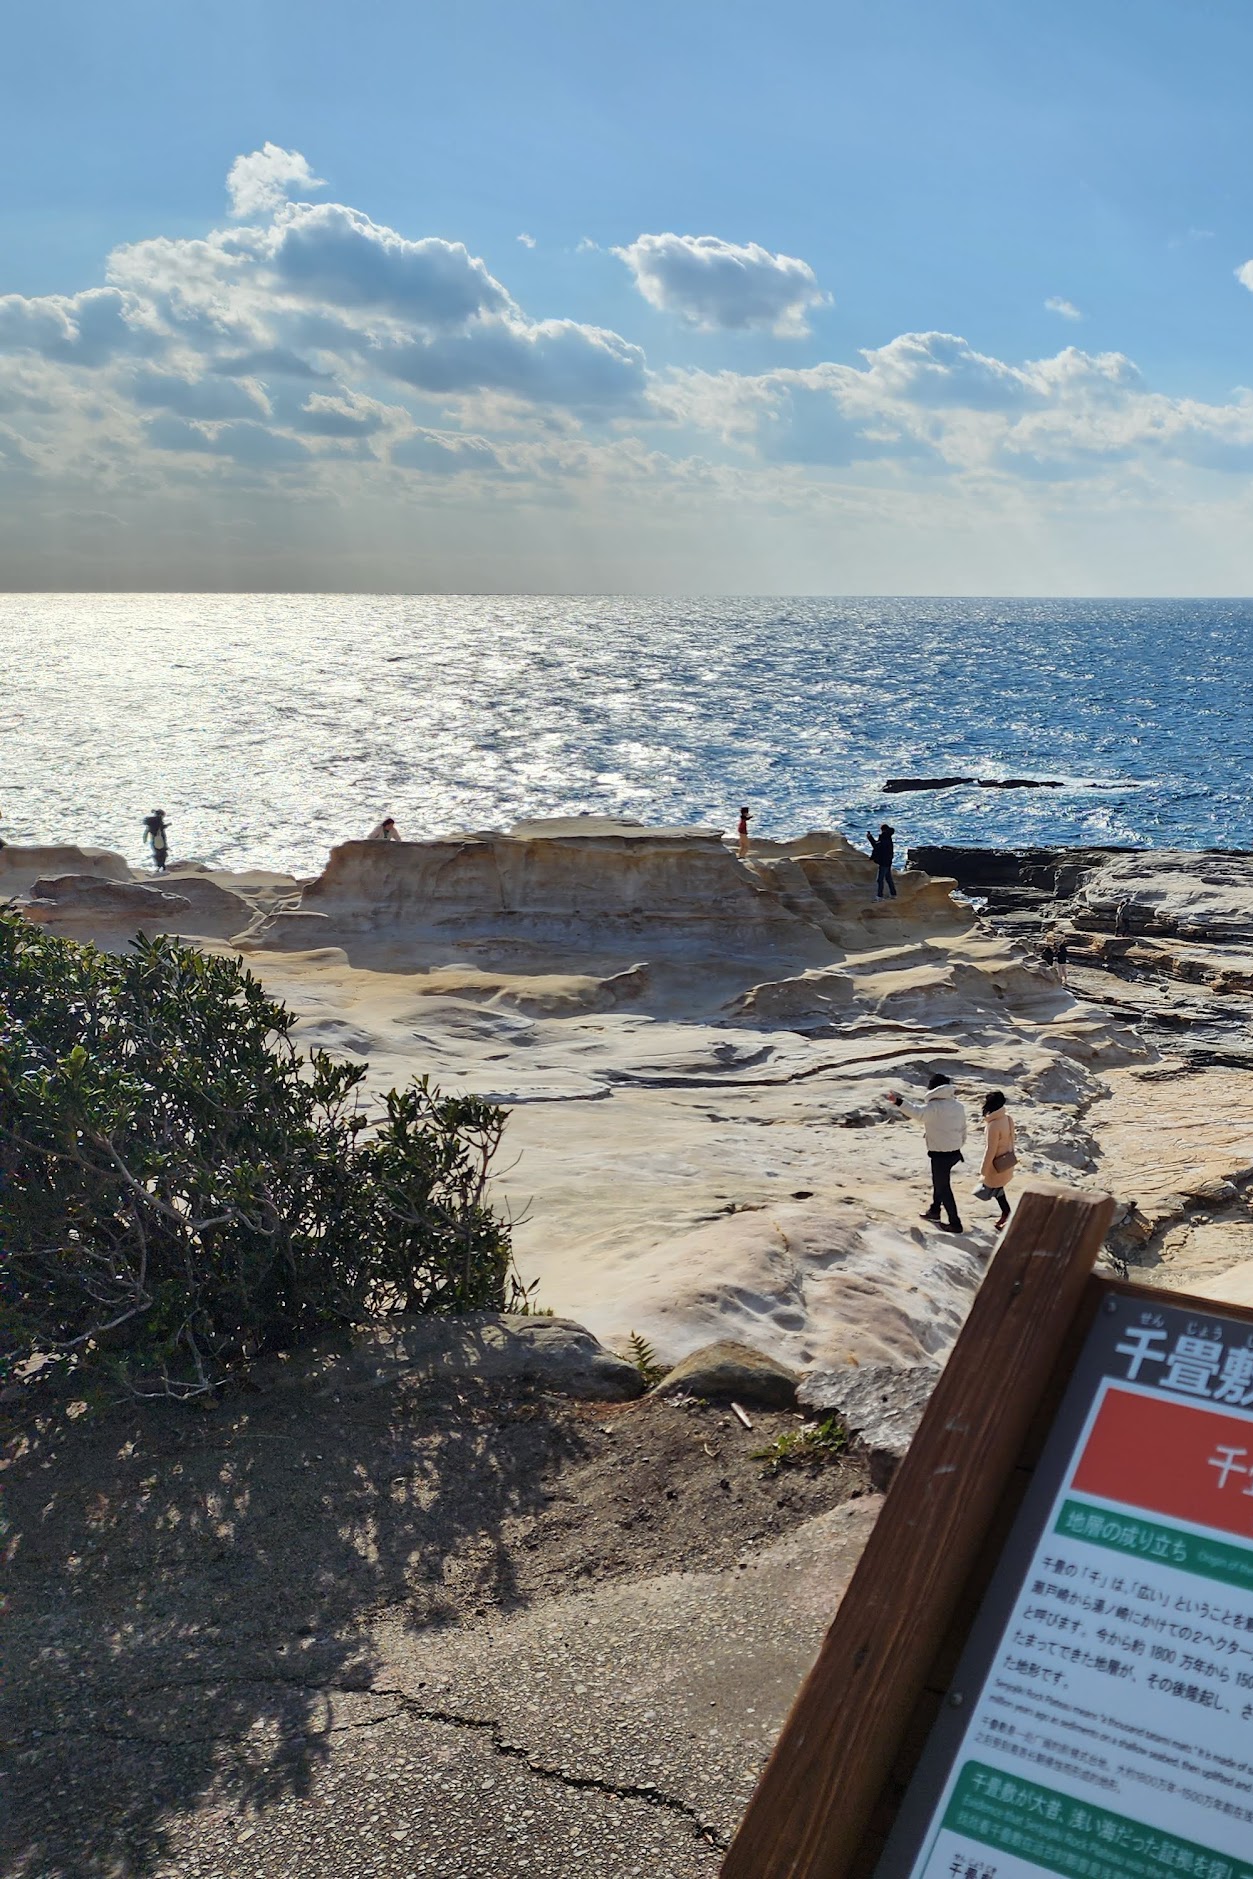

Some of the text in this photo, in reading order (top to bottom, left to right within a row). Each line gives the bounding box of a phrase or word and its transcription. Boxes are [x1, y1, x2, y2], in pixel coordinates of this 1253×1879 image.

[1064, 1510, 1188, 1563] 地層の成り立ち
[1003, 1654, 1070, 1690] た地形です。
[1150, 1644, 1177, 1664] 1800
